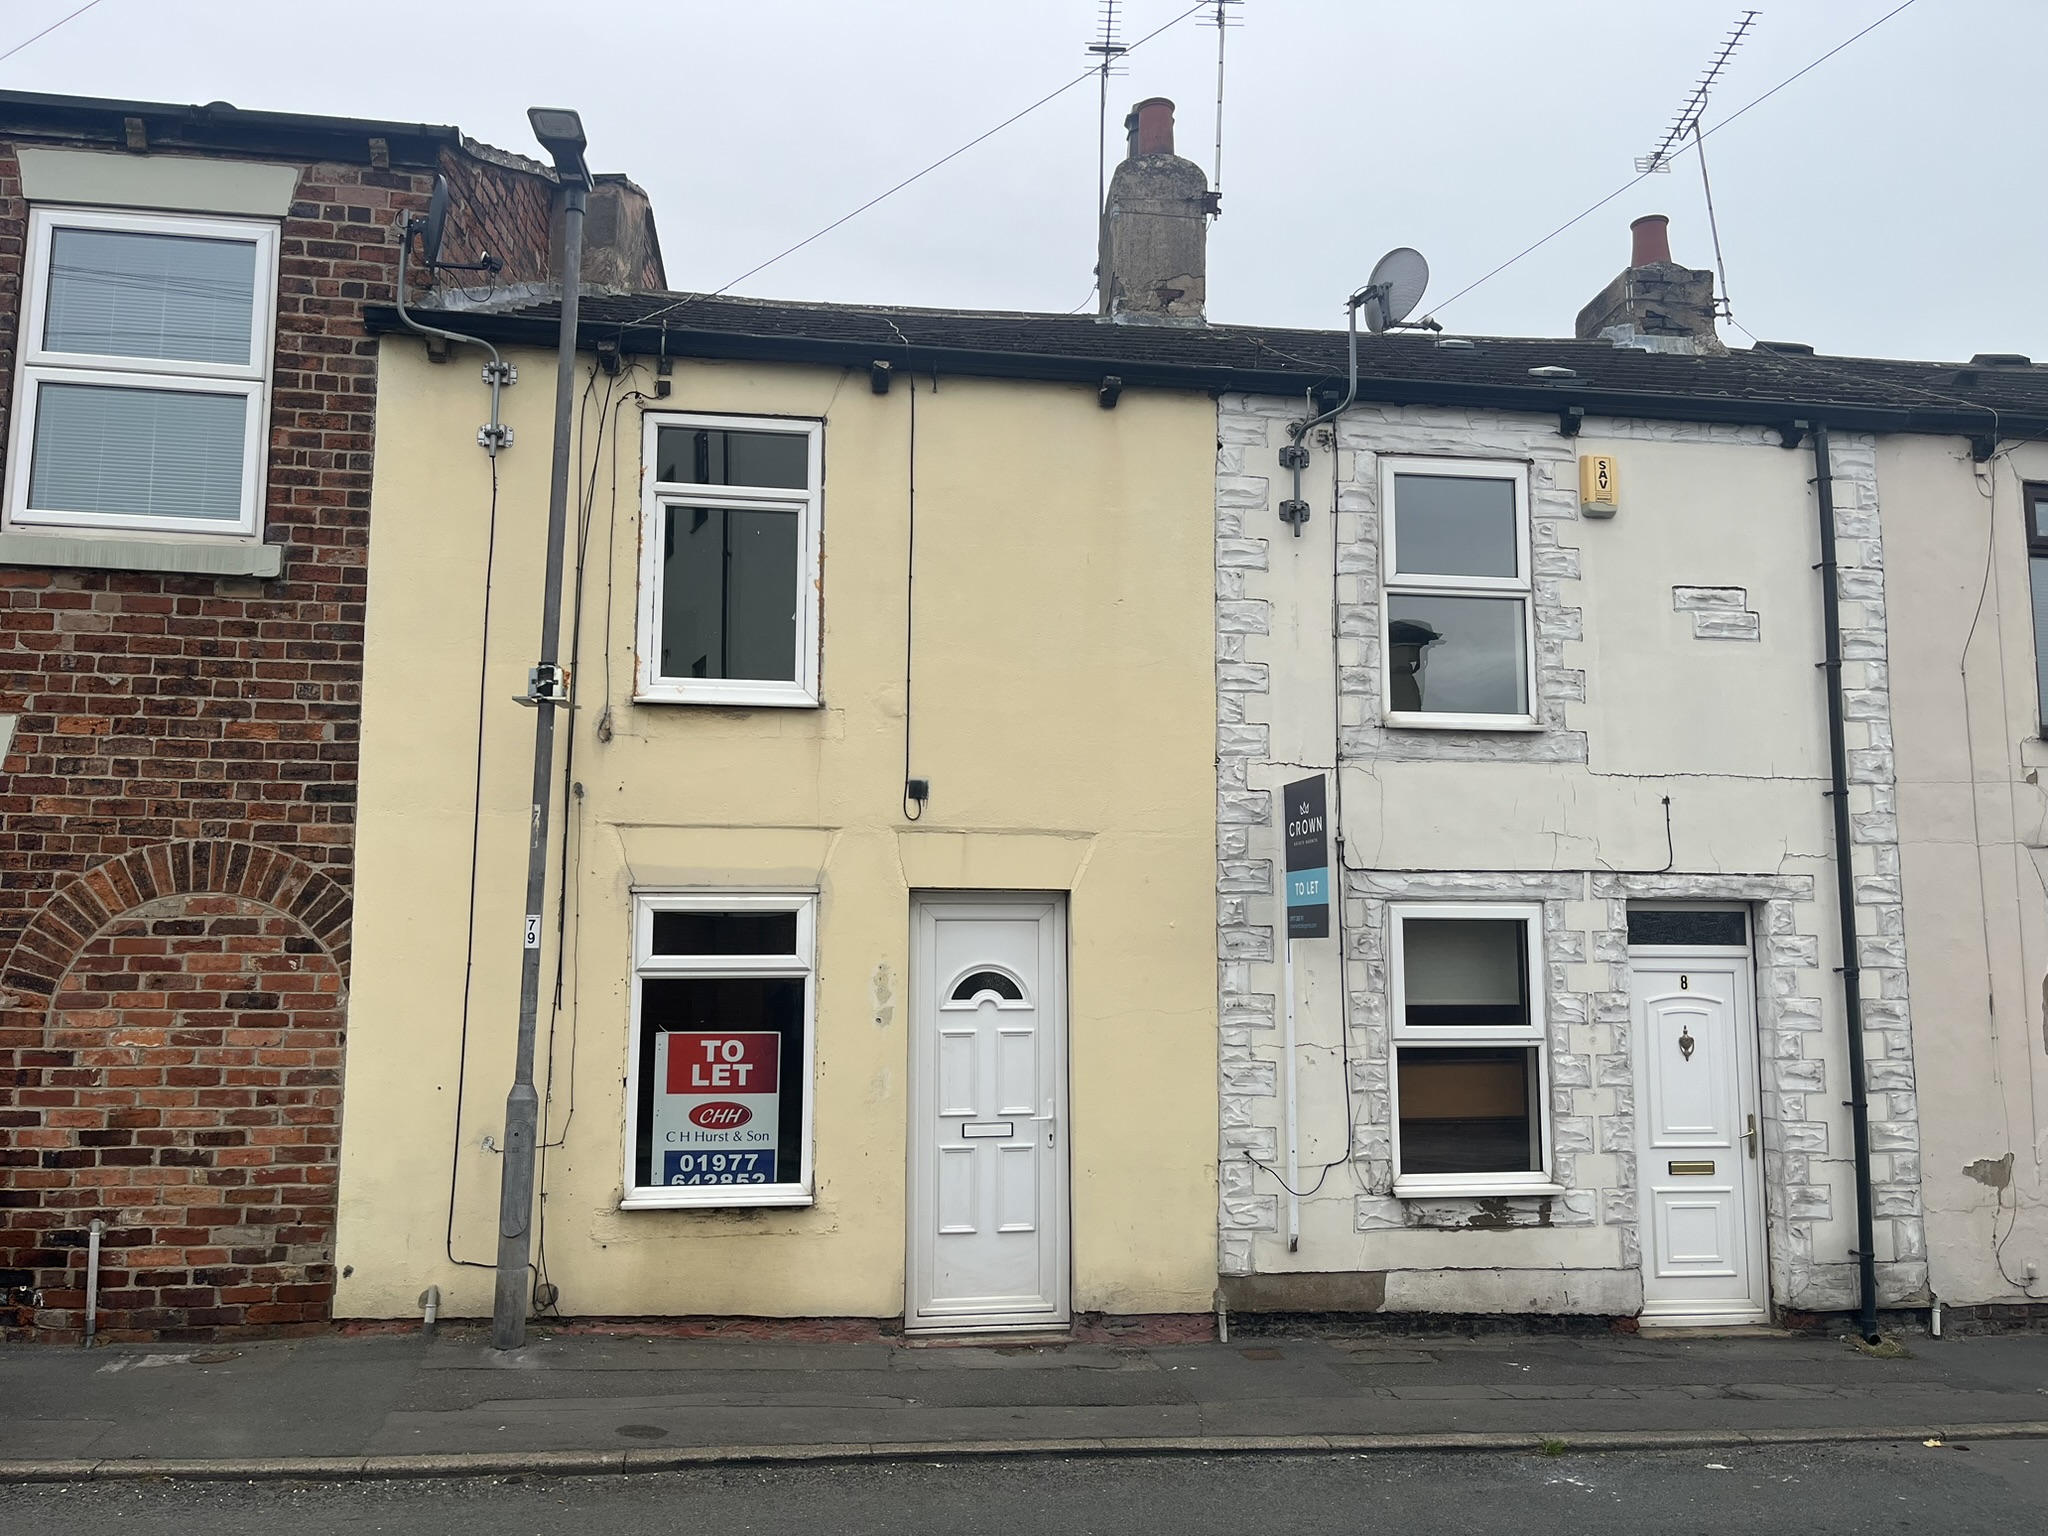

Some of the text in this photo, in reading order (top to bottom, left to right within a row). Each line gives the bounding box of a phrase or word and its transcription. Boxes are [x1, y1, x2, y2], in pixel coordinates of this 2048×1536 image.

[1598, 460, 1608, 489] SAV
[1289, 816, 1323, 837] CROWN
[1295, 880, 1319, 896] TO LET
[1680, 975, 1688, 990] 8
[700, 1040, 745, 1063] TO
[691, 1064, 754, 1087] LET
[699, 1108, 743, 1124] CHH
[666, 1130, 770, 1142] C H Hurst & Son
[680, 1154, 759, 1172] 01977
